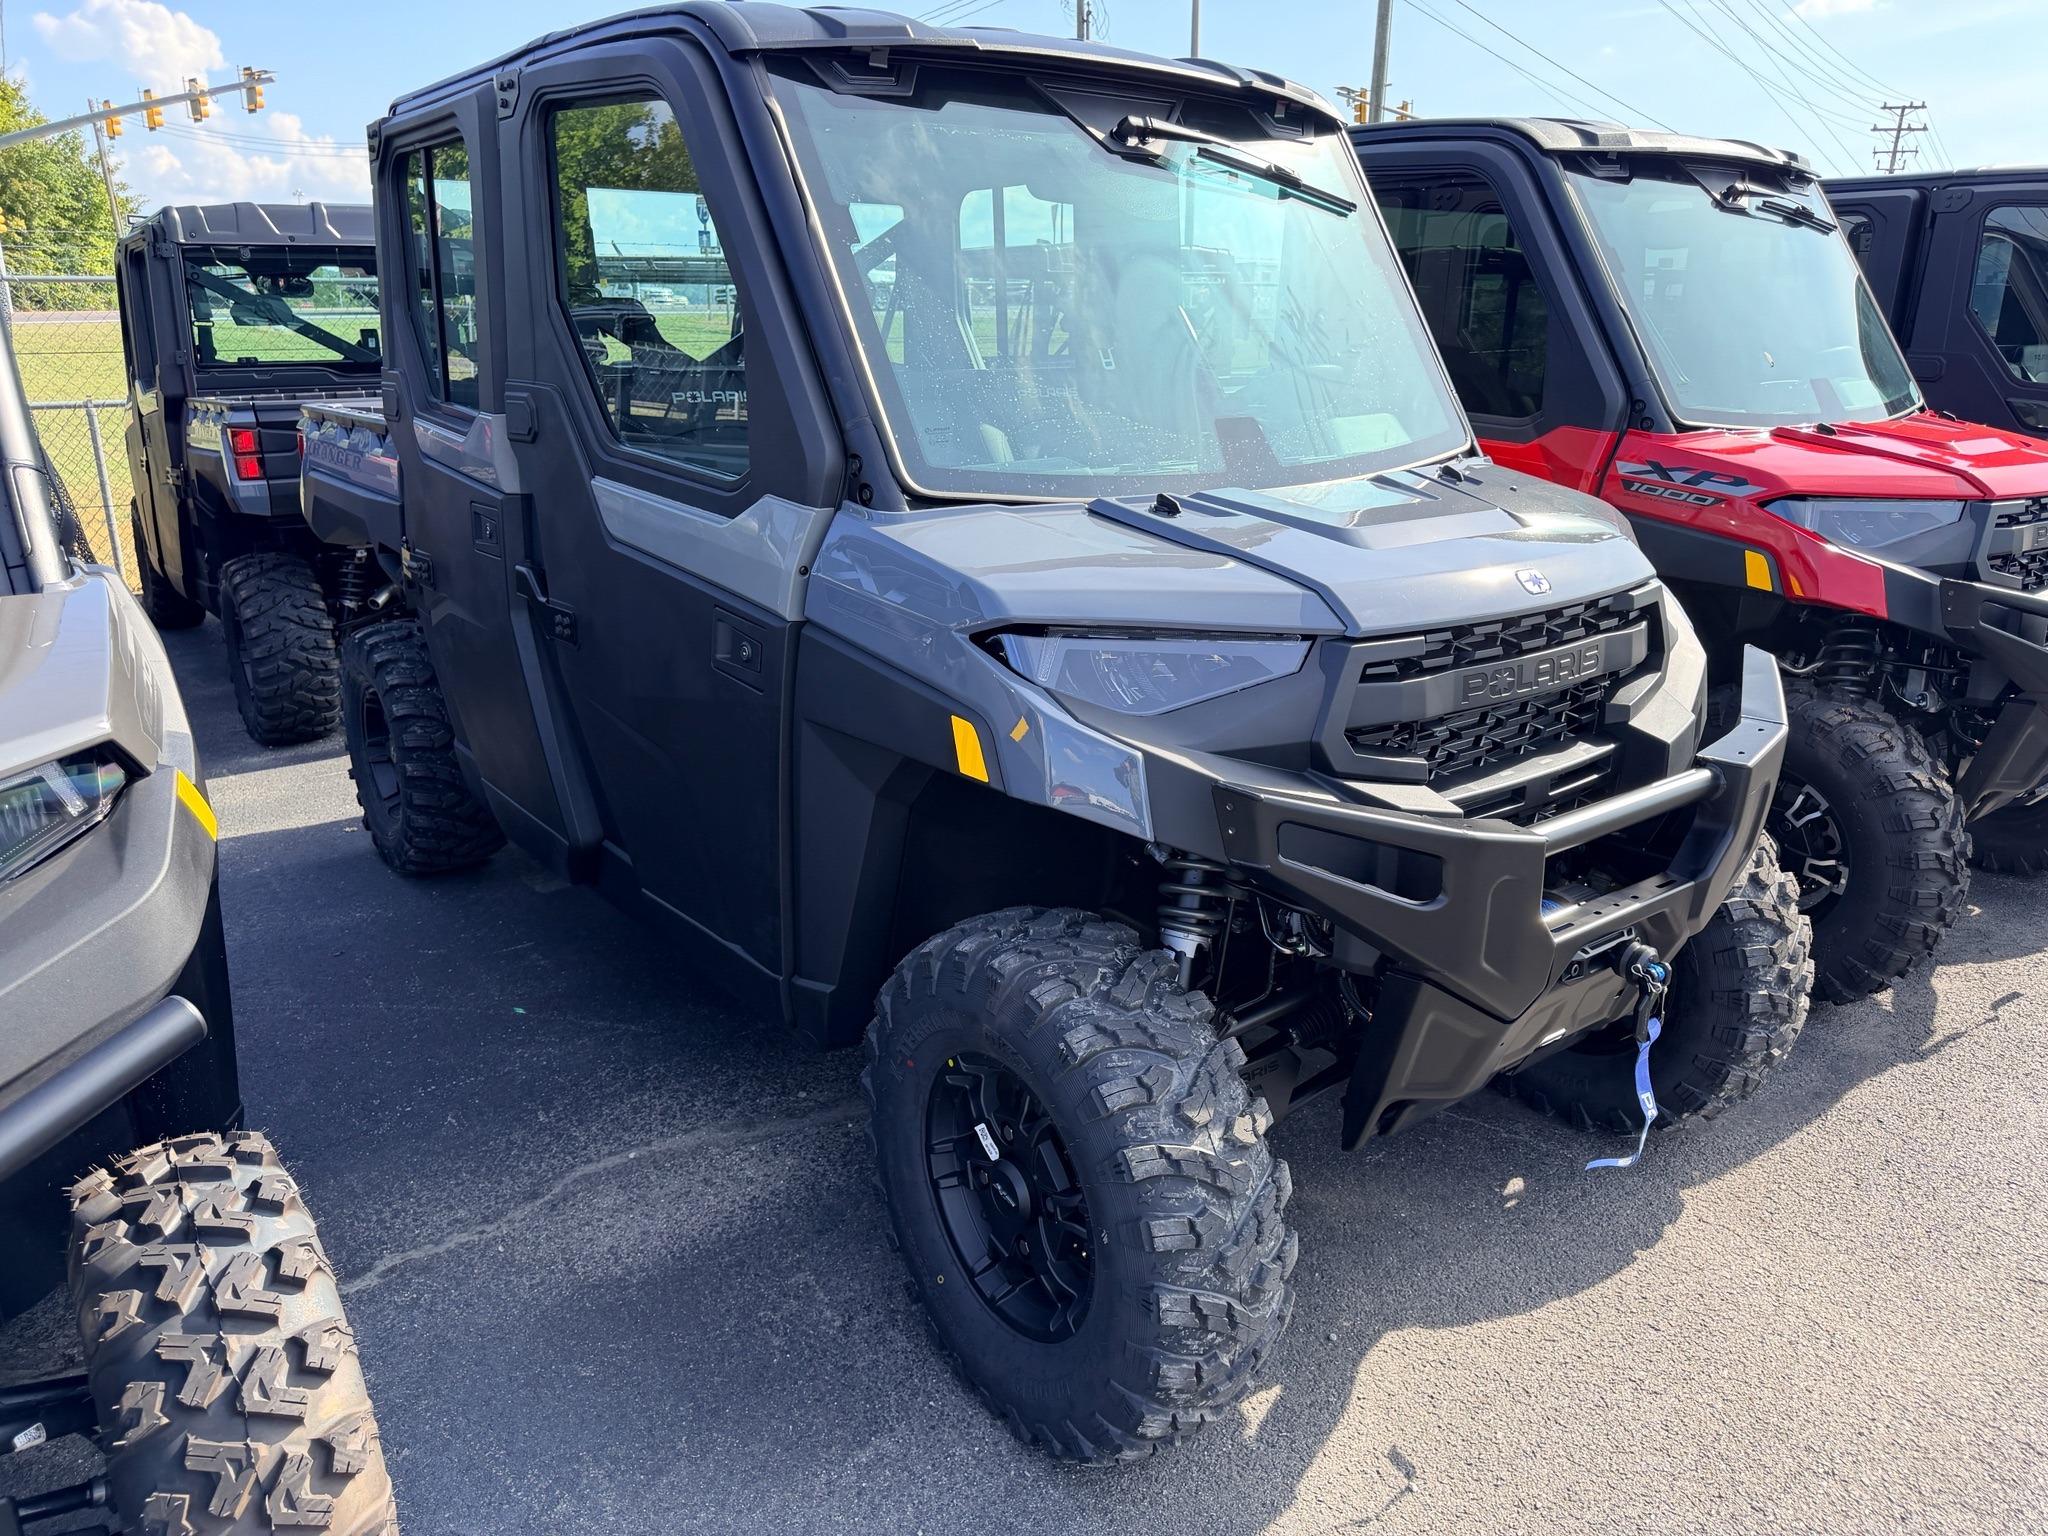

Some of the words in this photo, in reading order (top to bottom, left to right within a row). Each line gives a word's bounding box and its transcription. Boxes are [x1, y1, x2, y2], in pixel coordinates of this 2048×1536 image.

[312, 441, 362, 472] RANGER
[1623, 459, 1751, 488] XP
[1629, 482, 1716, 506] 1000
[1461, 644, 1599, 705] POLARIS
